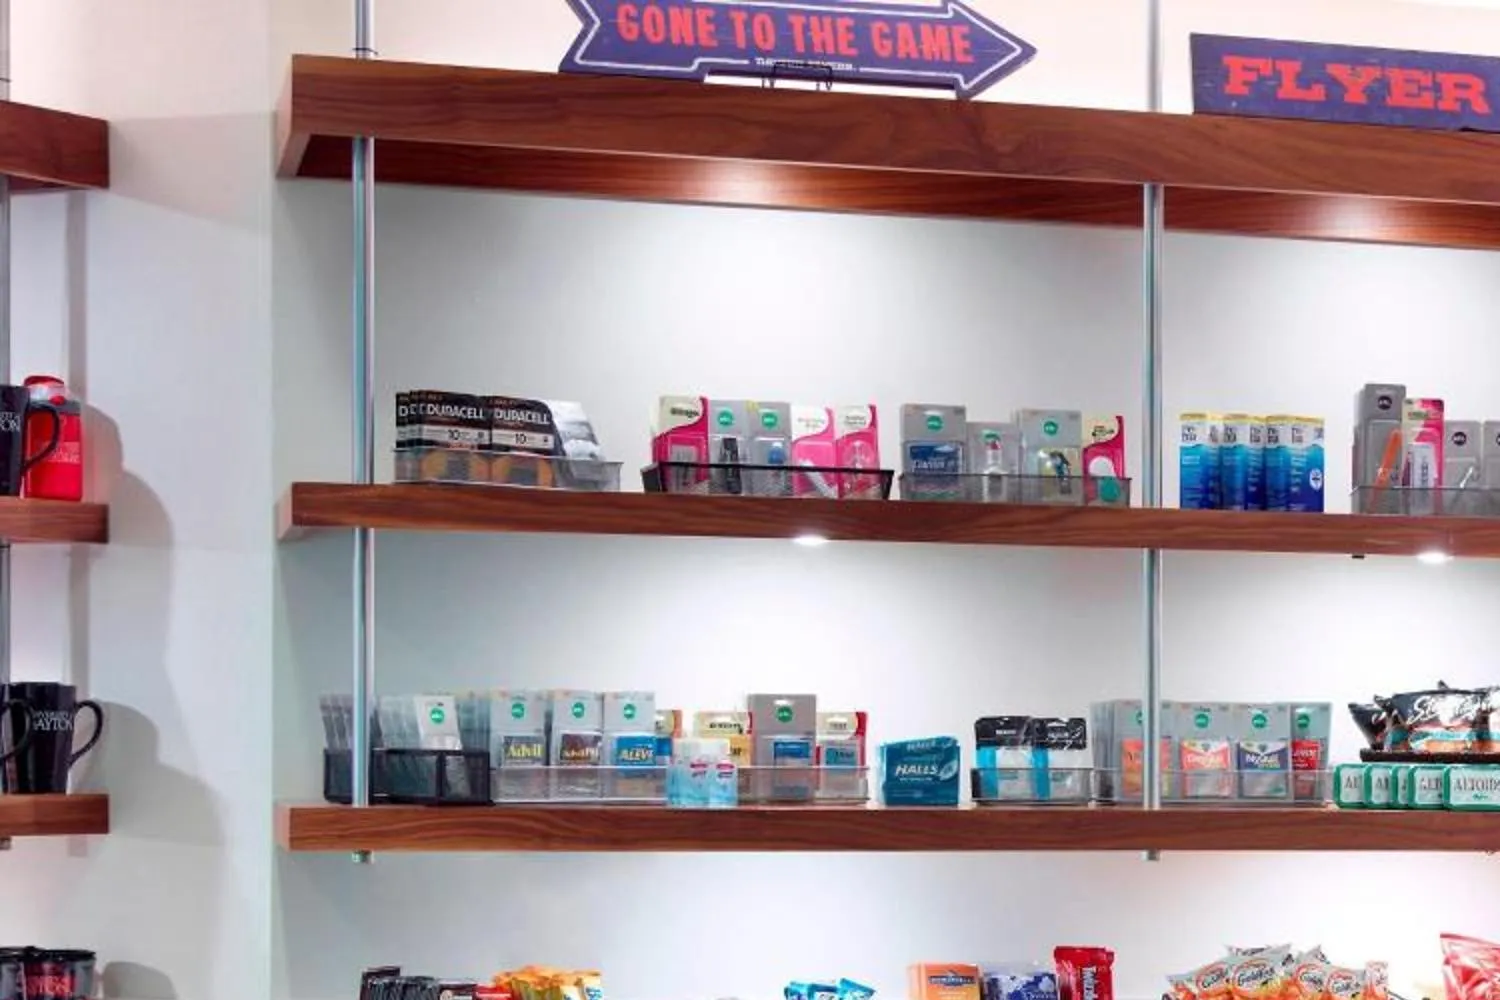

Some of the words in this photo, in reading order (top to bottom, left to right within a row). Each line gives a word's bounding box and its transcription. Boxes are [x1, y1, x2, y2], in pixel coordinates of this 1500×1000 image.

[617, 2, 718, 47] GONE
[728, 10, 777, 51] TO
[788, 14, 858, 57] THE
[870, 21, 975, 64] GAME
[1222, 54, 1492, 115] FLYER
[427, 403, 485, 420] DURACELL
